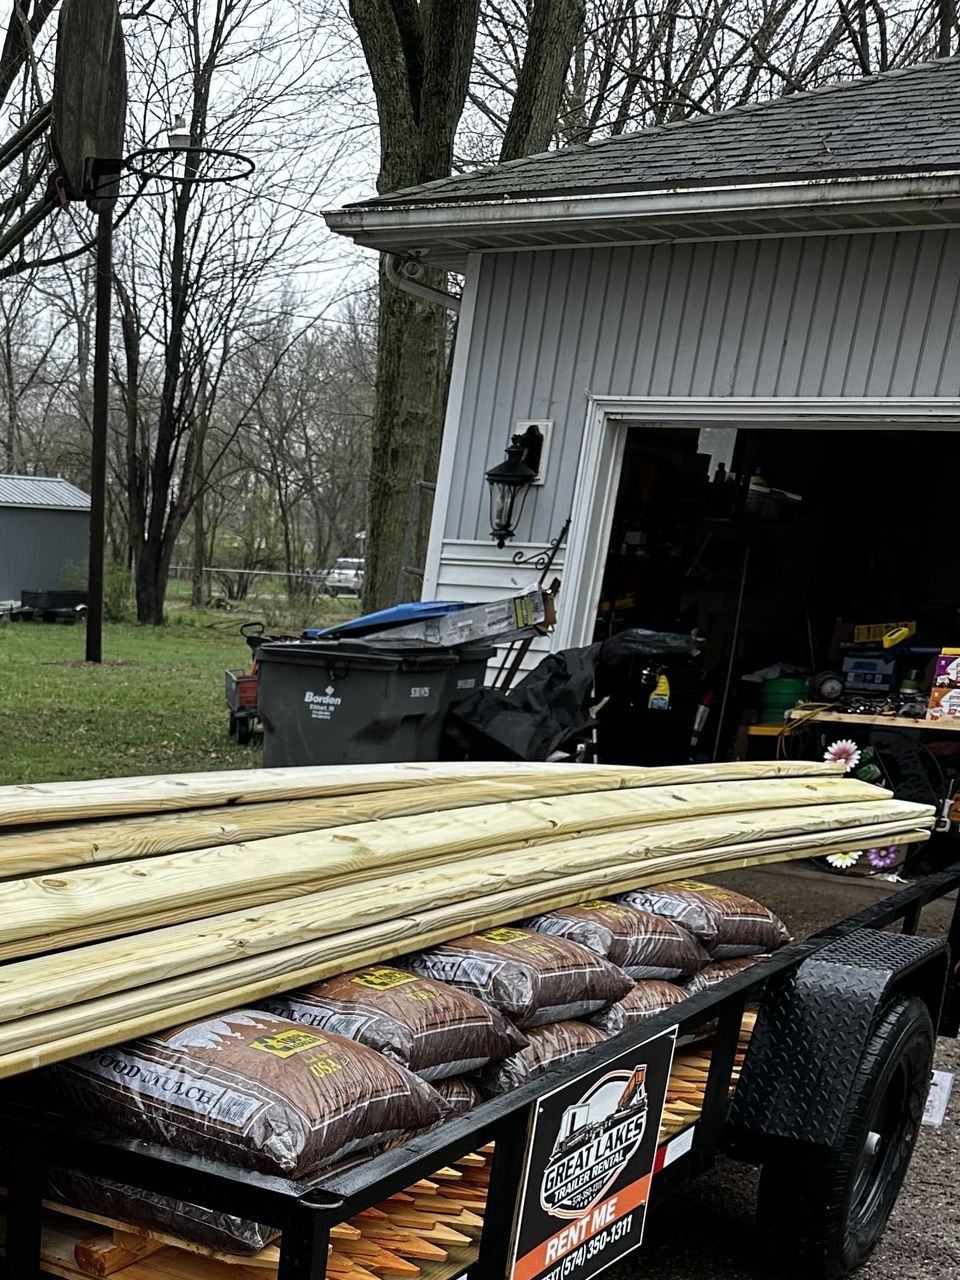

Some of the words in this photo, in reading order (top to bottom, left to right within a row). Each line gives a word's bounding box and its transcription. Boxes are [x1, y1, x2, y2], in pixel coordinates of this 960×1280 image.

[304, 691, 342, 705] Borden
[141, 1071, 218, 1106] MULCH
[309, 1059, 342, 1078] USA
[544, 1143, 594, 1194] GREAT
[594, 1116, 644, 1163] LAKES
[553, 1169, 591, 1203] TRAILER
[591, 1151, 625, 1180] RENTAL
[544, 1215, 590, 1266] RENT
[590, 1197, 618, 1233] ME
[559, 1246, 587, 1280] (574)
[586, 1214, 633, 1260] 350-1311
